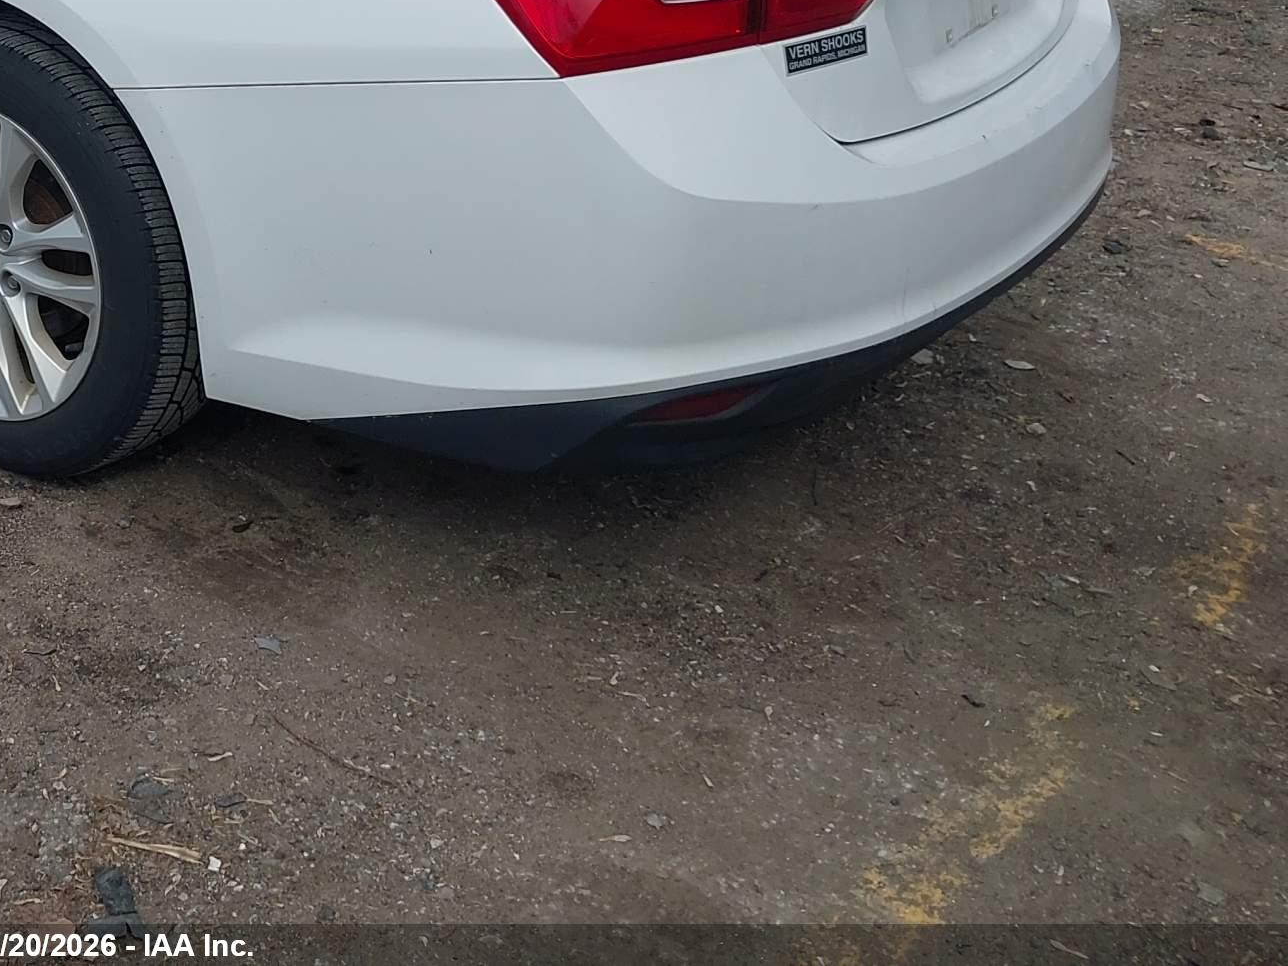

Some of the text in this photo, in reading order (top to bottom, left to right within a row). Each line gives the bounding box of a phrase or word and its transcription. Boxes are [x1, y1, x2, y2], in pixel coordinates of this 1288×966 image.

[788, 30, 865, 60] VERN SHOOKS
[789, 57, 813, 70] GRAND
[837, 43, 866, 58] MICHIGAN
